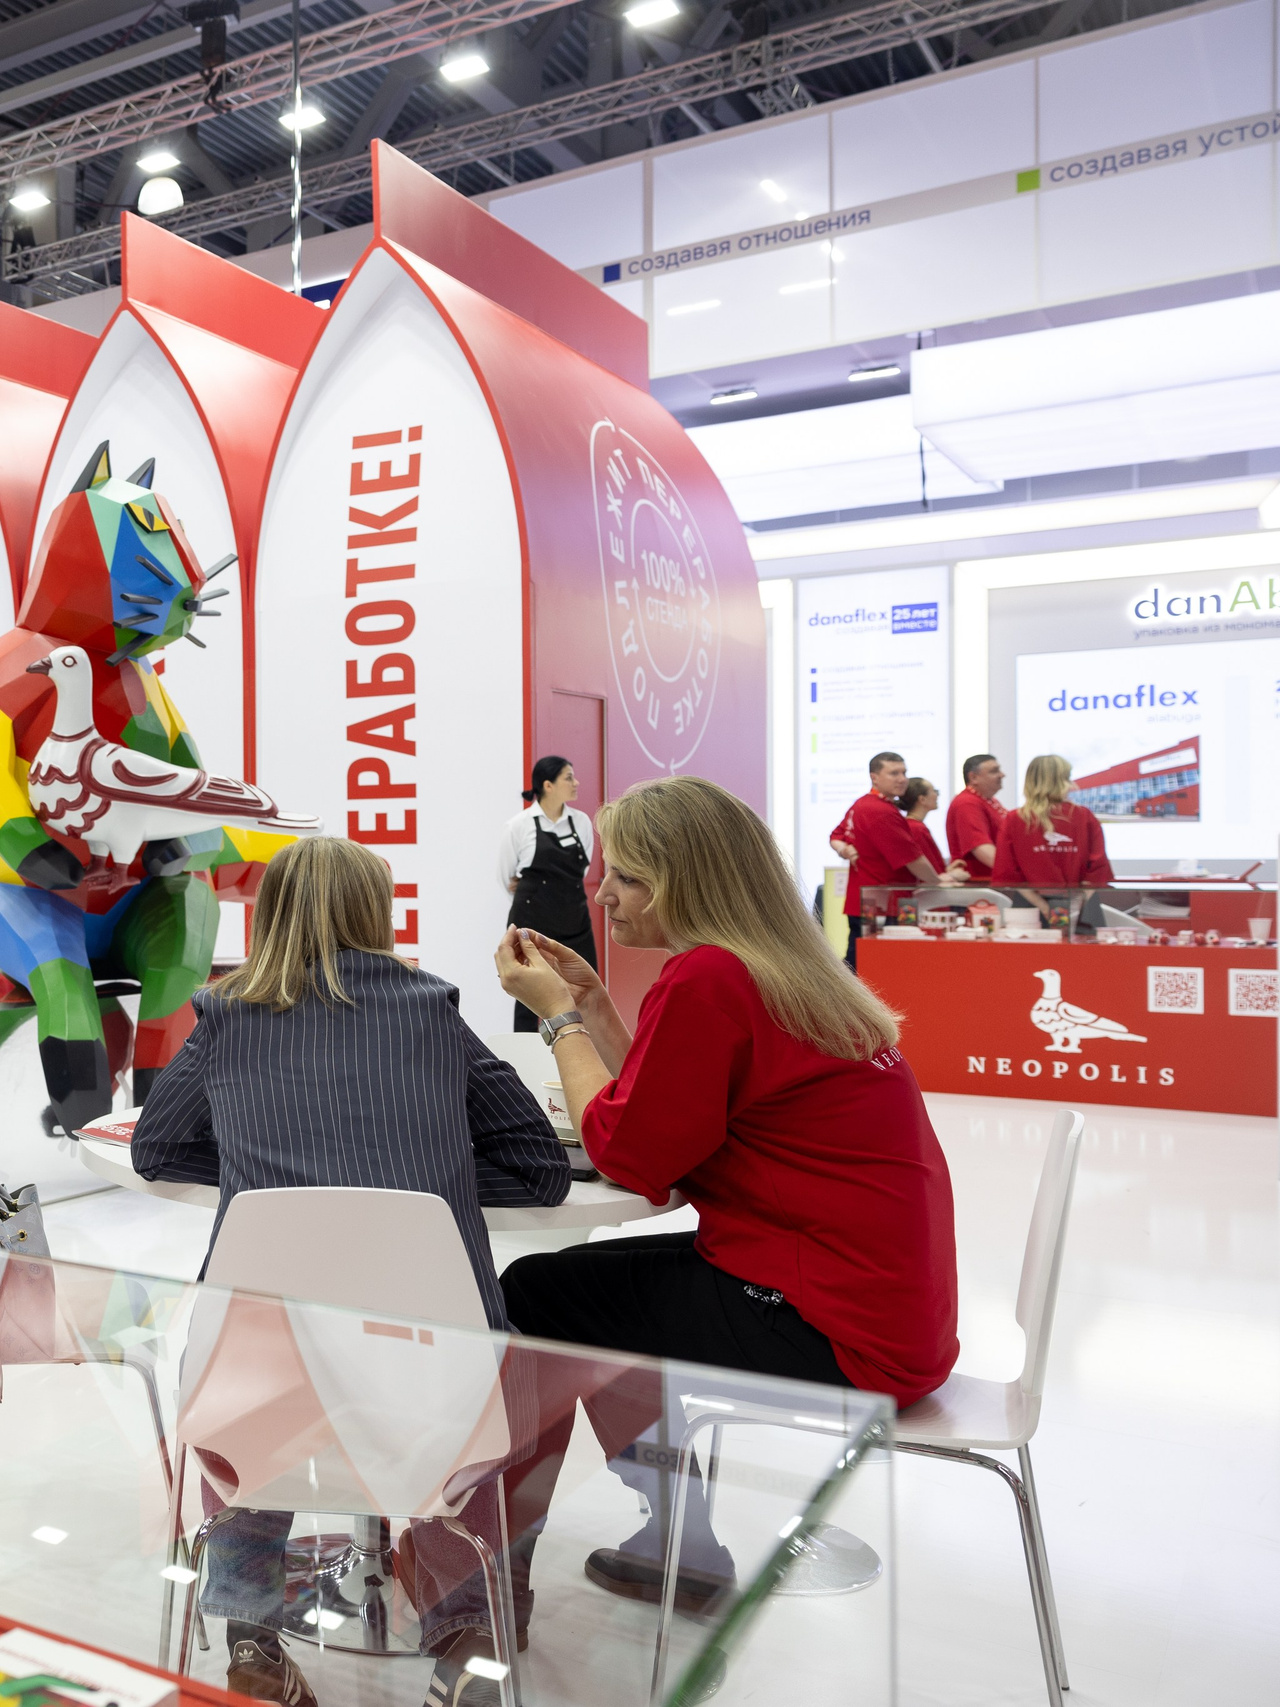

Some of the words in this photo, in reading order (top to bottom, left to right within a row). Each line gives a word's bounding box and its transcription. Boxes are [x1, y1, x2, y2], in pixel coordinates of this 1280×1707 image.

[1049, 137, 1189, 183] создавая
[627, 239, 731, 276] создавая
[738, 208, 872, 251] отношения
[641, 548, 687, 598] 100%
[808, 607, 888, 627] danaflex
[893, 608, 911, 620] 25
[911, 607, 937, 619] лет
[345, 424, 423, 968] ЕРАБОТКЕ!
[1048, 684, 1199, 712] danaflex
[967, 1056, 1176, 1087] NEOPOLIS
